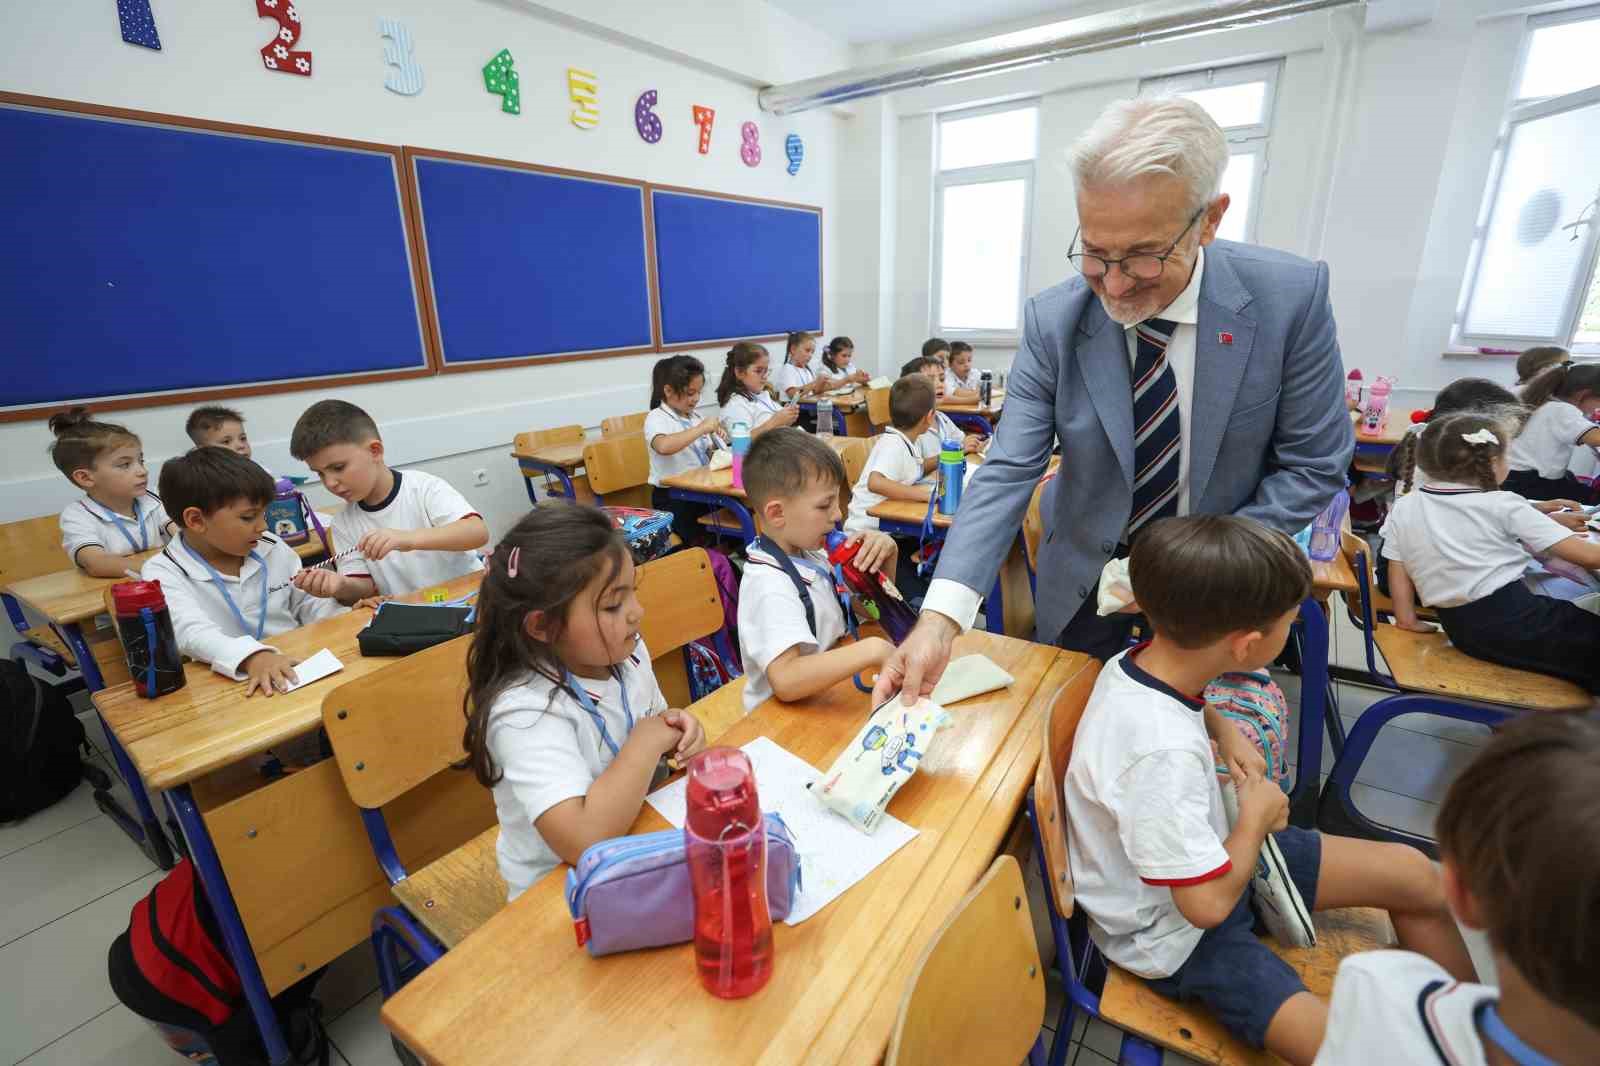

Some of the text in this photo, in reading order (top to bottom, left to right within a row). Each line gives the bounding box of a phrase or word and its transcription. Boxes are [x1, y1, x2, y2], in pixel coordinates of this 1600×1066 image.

[257, 0, 804, 176] 2 3 4 5 6 7 8 9
